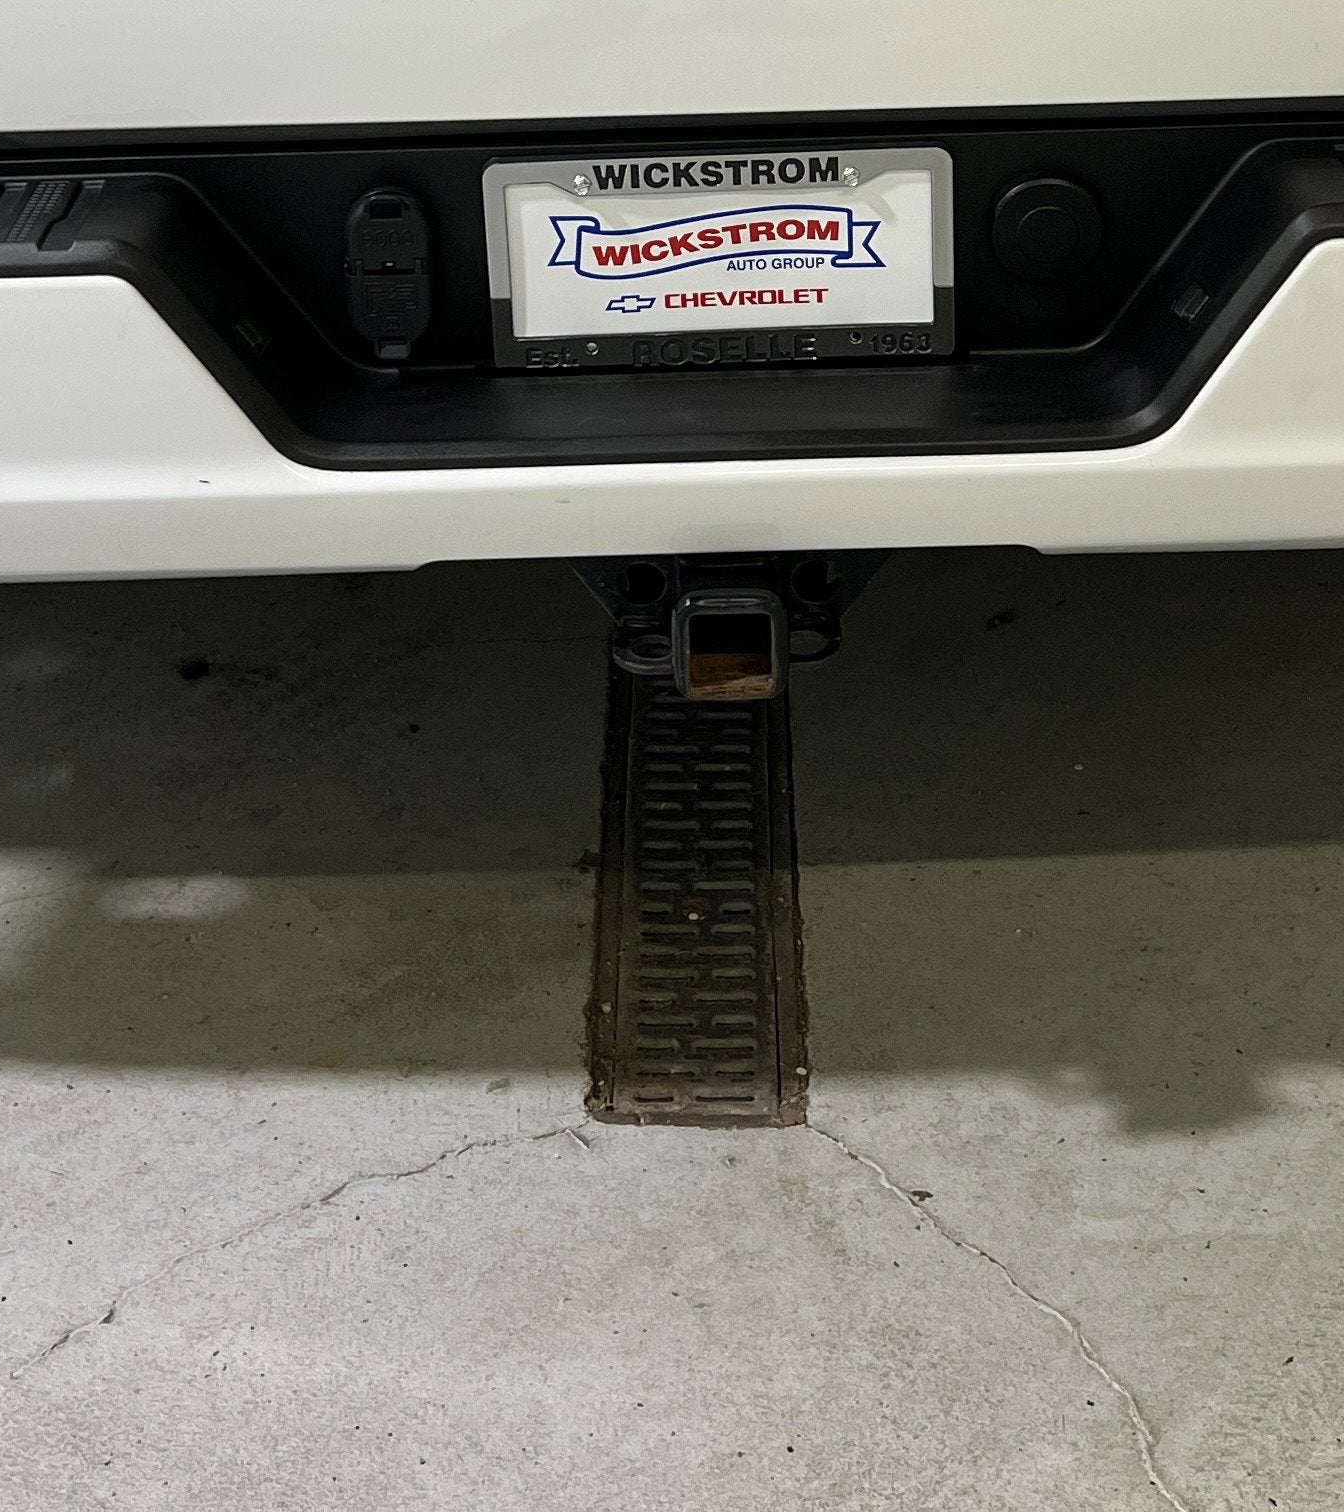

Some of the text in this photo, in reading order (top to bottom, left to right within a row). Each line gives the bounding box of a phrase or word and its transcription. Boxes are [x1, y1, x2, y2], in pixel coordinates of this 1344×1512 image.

[592, 156, 840, 190] WICKSTROM
[592, 219, 840, 267] WICKSTROM
[726, 256, 826, 272] AUTO GROUP
[664, 287, 830, 310] CHEVROLET
[632, 332, 818, 367] ROSELLE
[868, 332, 934, 355] 1963
